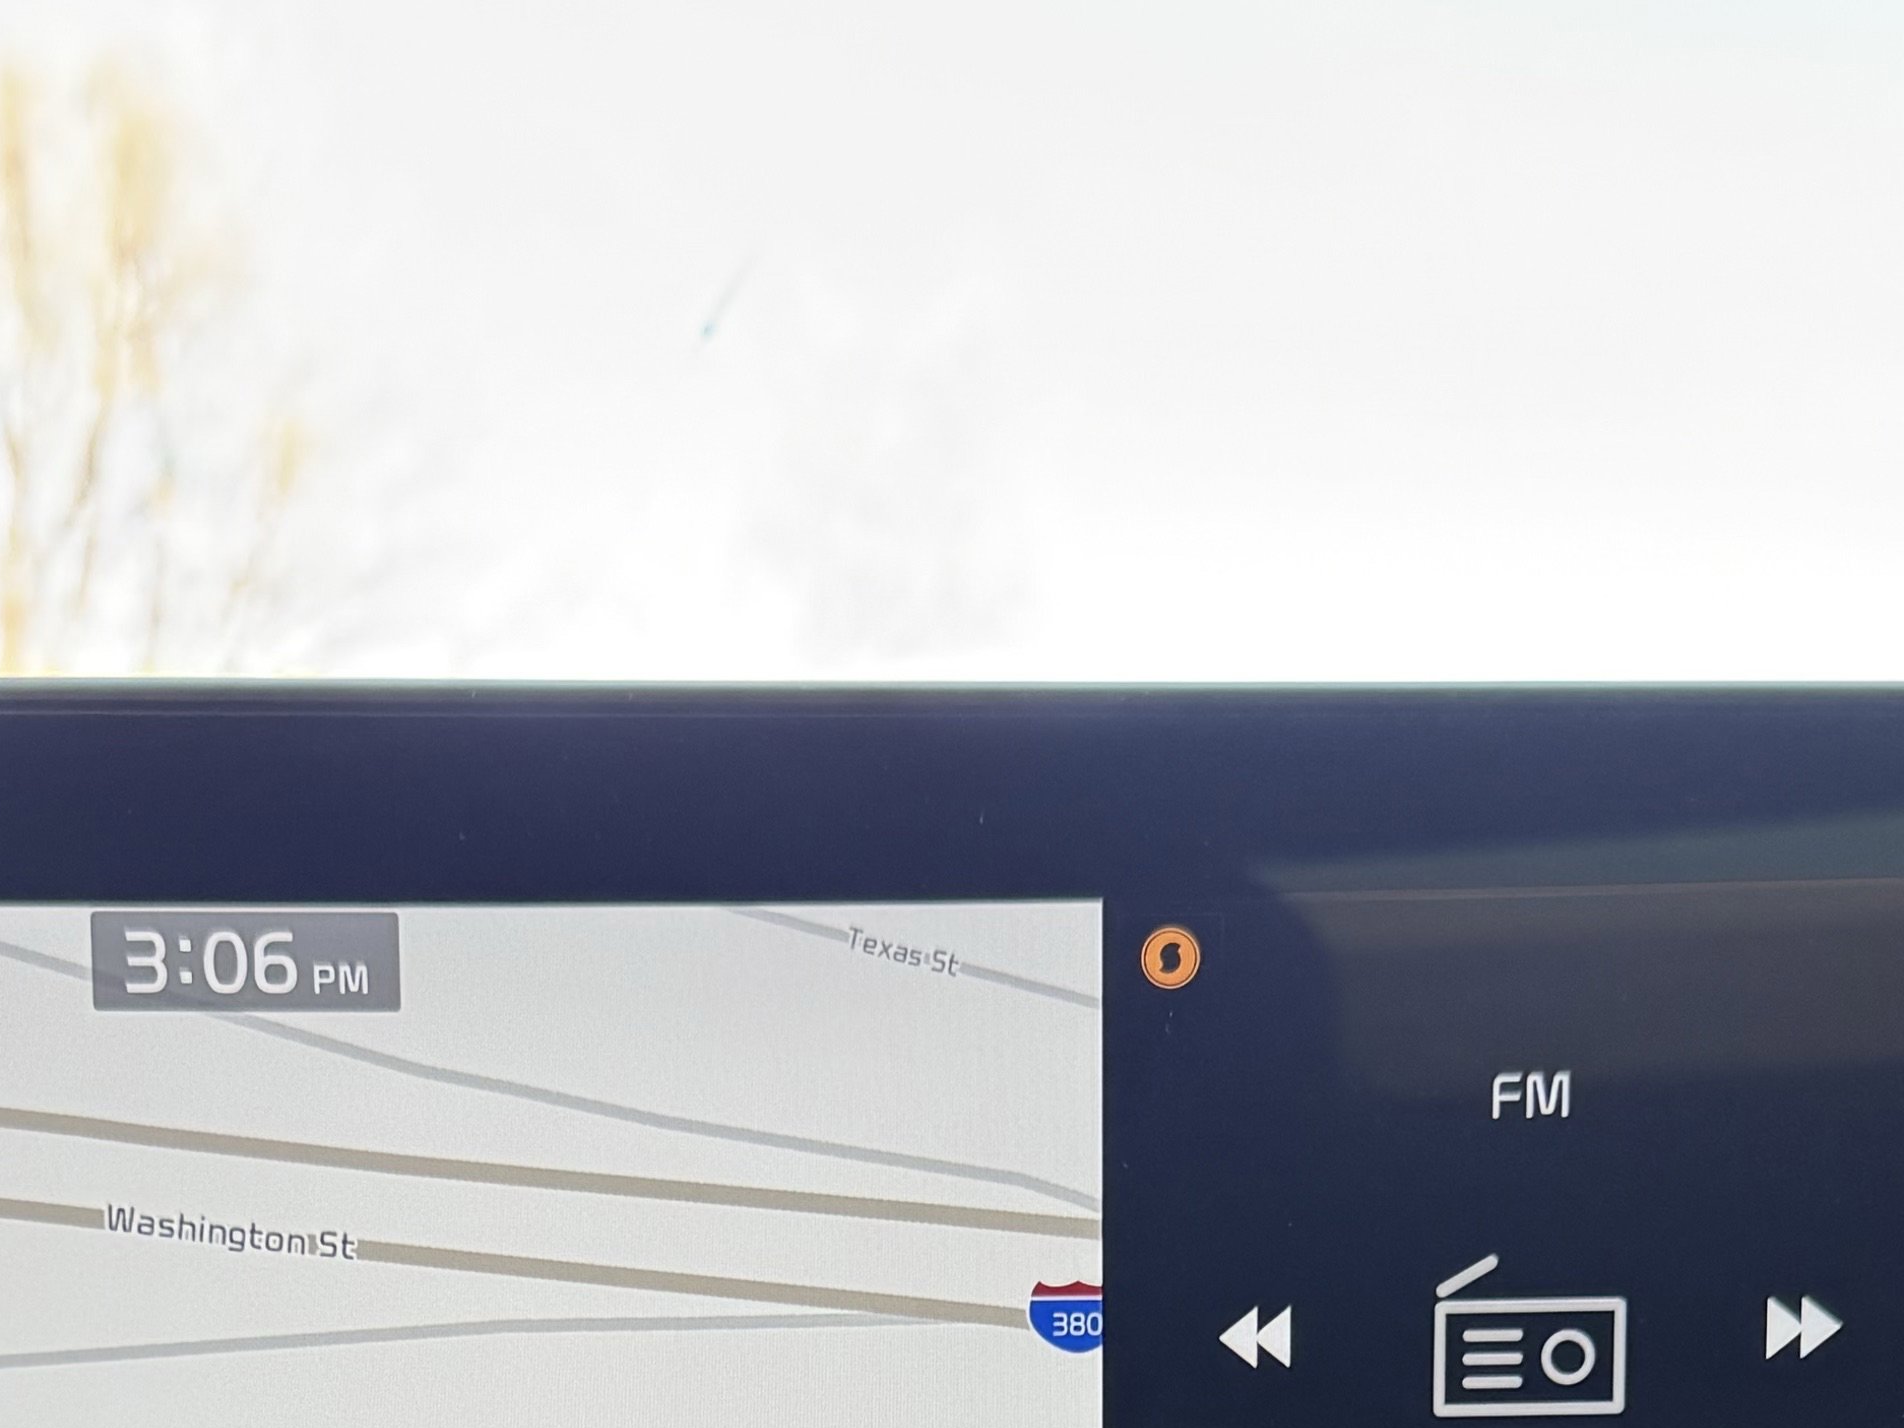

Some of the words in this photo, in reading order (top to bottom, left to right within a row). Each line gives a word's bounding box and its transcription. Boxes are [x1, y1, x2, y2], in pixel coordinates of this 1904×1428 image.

[123, 929, 297, 995] 3:06
[314, 963, 368, 995] PM
[849, 927, 922, 966] Texas
[931, 951, 959, 977] St
[1492, 1071, 1571, 1119] FM
[108, 1203, 305, 1255] Washington
[320, 1231, 355, 1260] St
[1052, 1312, 1103, 1336] 380
